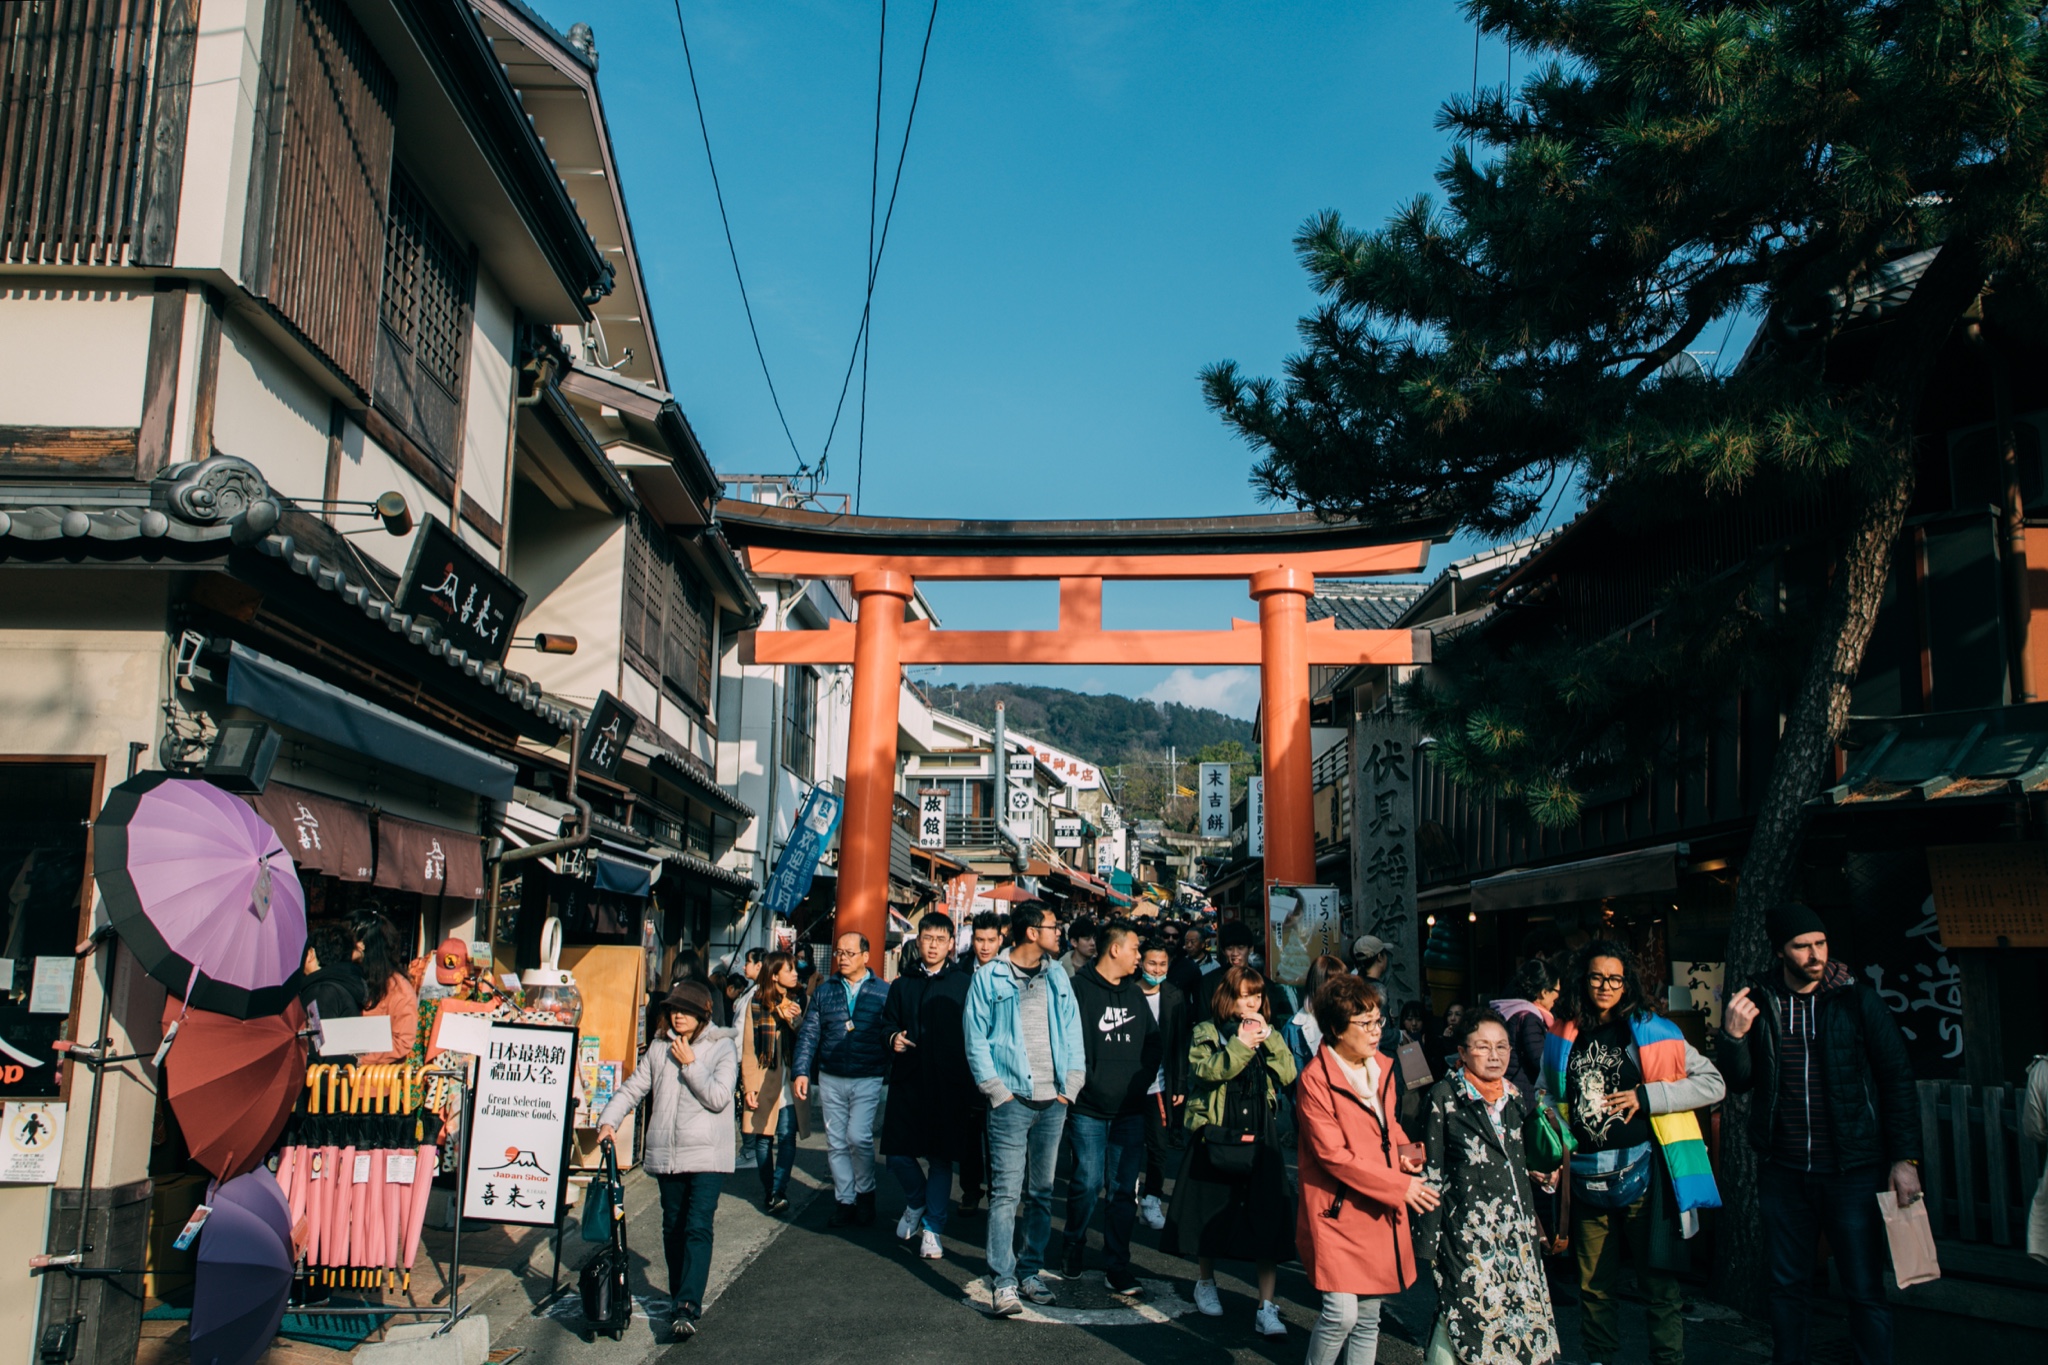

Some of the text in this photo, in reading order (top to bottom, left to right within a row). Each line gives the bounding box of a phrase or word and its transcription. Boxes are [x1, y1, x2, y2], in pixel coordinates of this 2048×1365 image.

[1207, 769, 1224, 832] 末吉餅
[923, 795, 942, 835] 旅館
[1105, 1033, 1130, 1042] AIR
[489, 1041, 566, 1065] 日本最熱銷
[0, 1065, 24, 1084] p
[488, 1093, 551, 1108] Great Selection
[481, 1105, 559, 1122] of Japanese Goods.
[493, 1171, 549, 1182] Japan Shop
[481, 1182, 546, 1210] 喜来々
